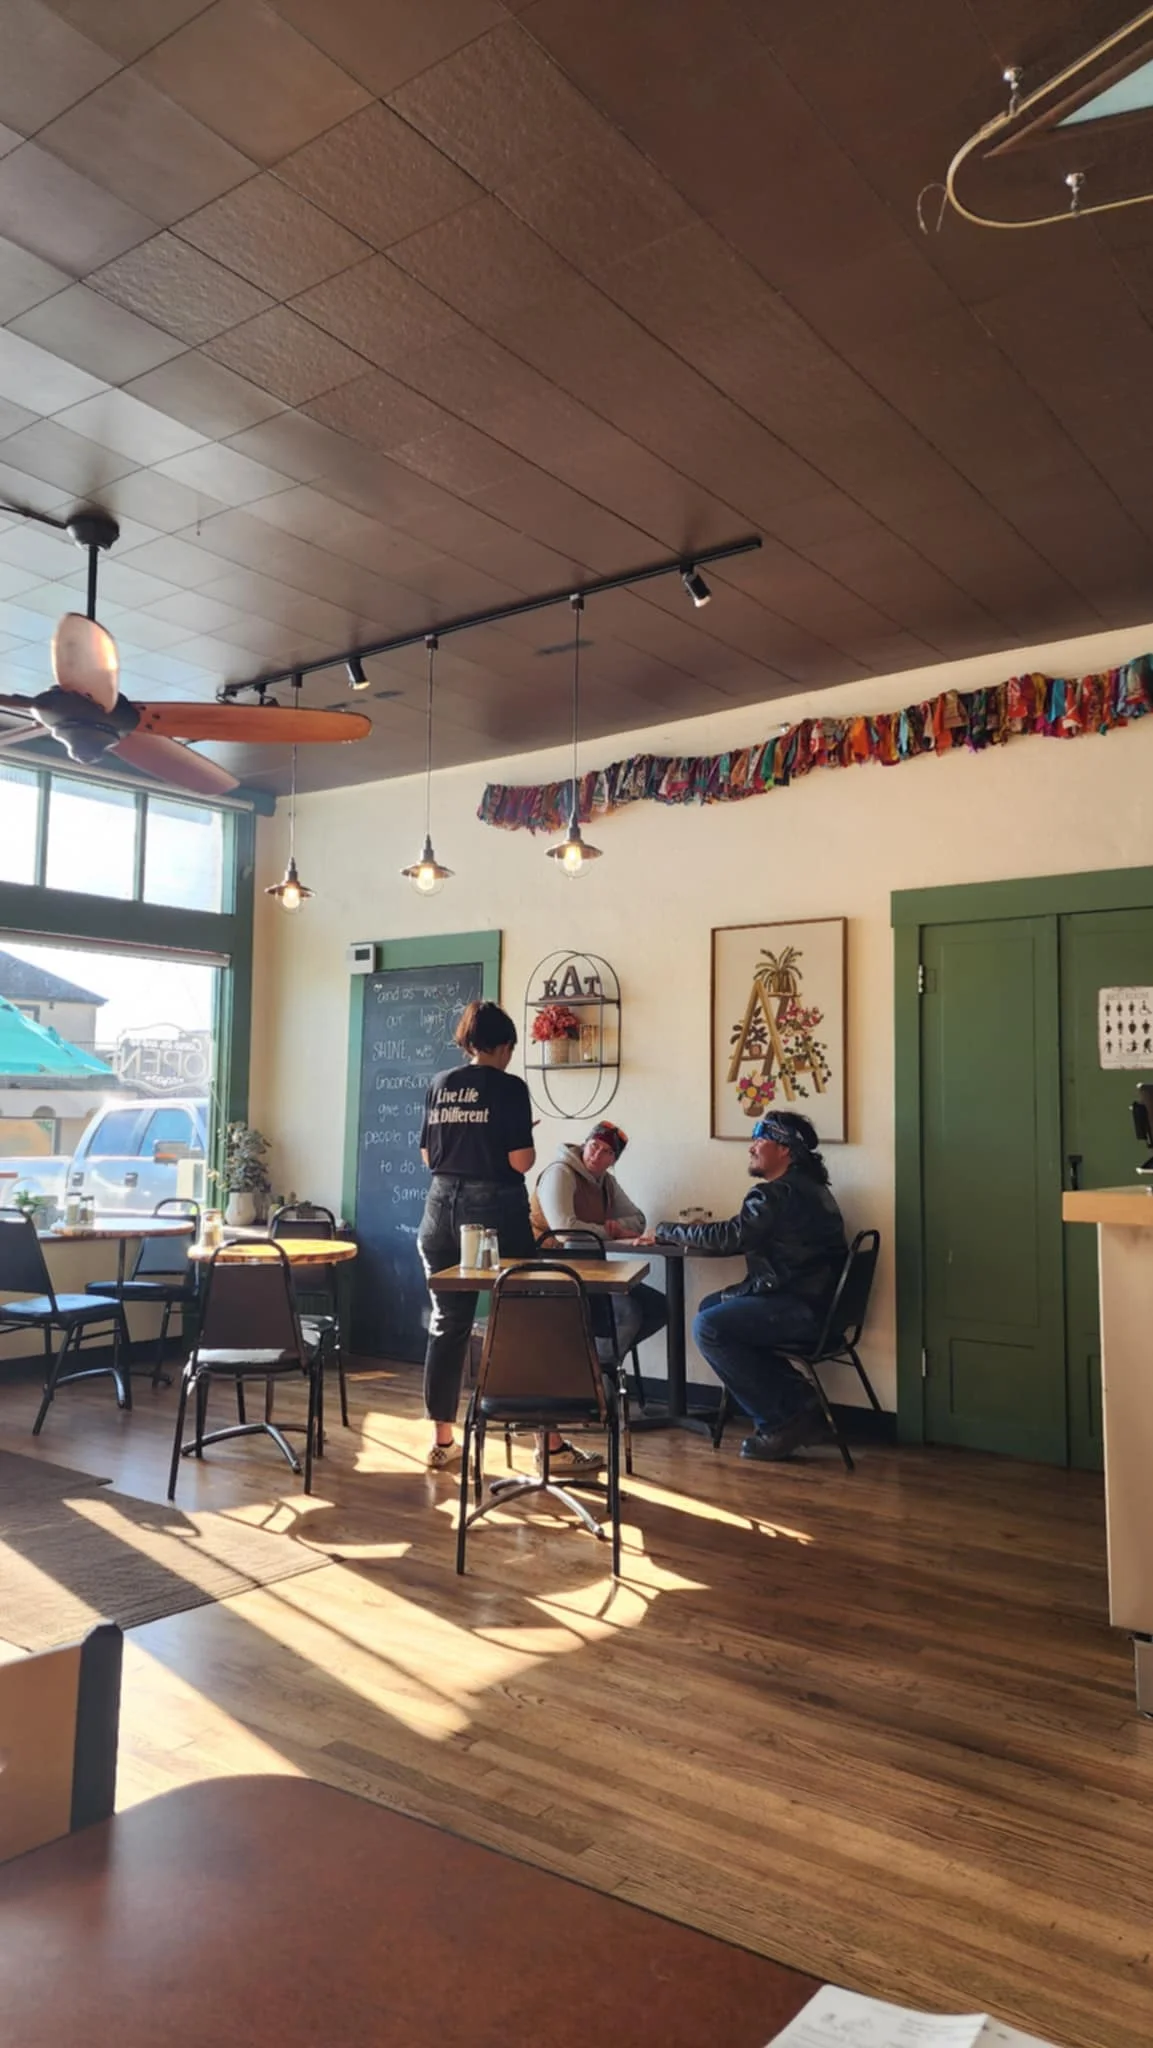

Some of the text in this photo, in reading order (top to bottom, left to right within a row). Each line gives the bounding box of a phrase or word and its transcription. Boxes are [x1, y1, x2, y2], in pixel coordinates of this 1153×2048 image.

[542, 965, 602, 999] EAT
[415, 1044, 433, 1058] we
[437, 1087, 479, 1103] Live Life
[440, 1106, 489, 1123] Different
[380, 1160, 392, 1174] to
[400, 1160, 416, 1174] do
